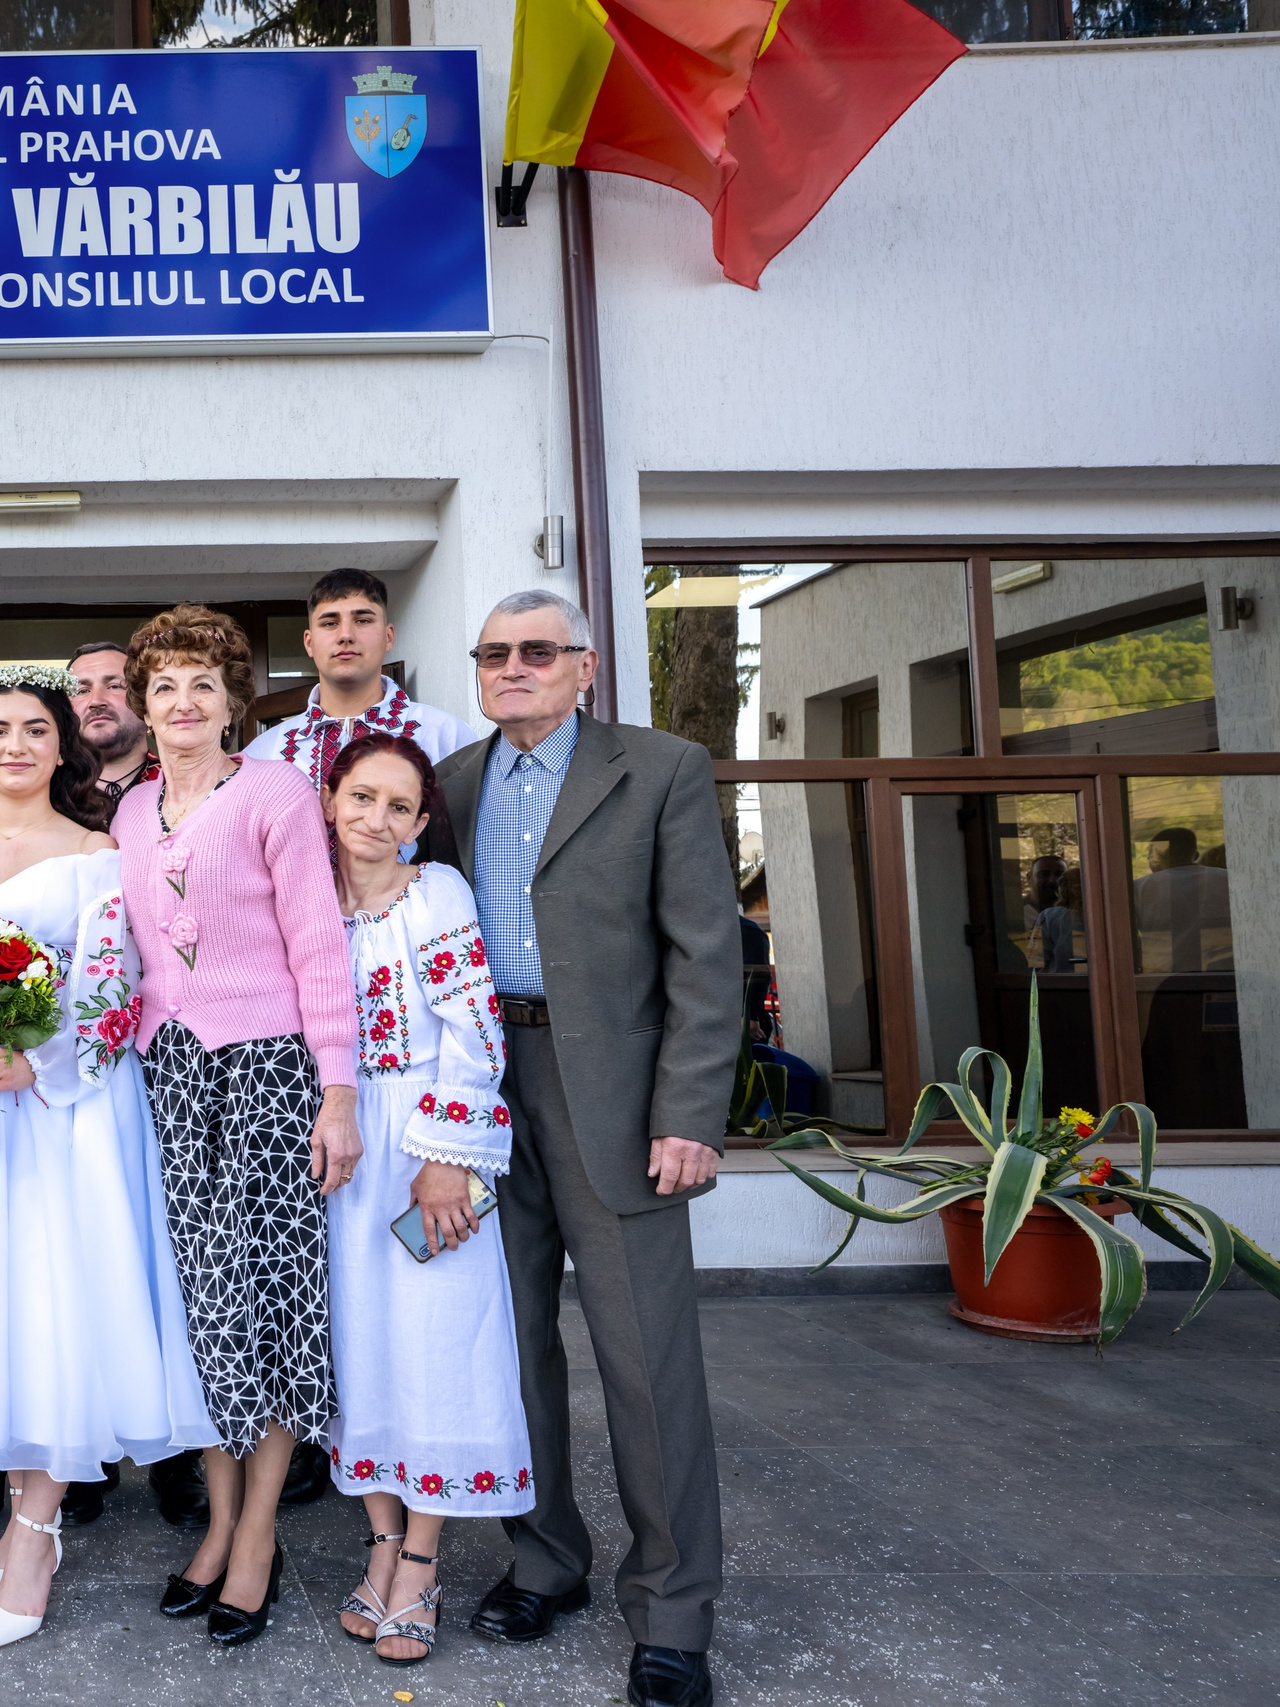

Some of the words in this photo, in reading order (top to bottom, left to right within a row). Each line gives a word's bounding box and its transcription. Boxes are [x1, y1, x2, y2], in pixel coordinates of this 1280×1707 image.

[21, 128, 222, 163] PRAHOVA
[11, 168, 361, 258] VĂRBILĂU
[219, 267, 365, 305] LOCAL
